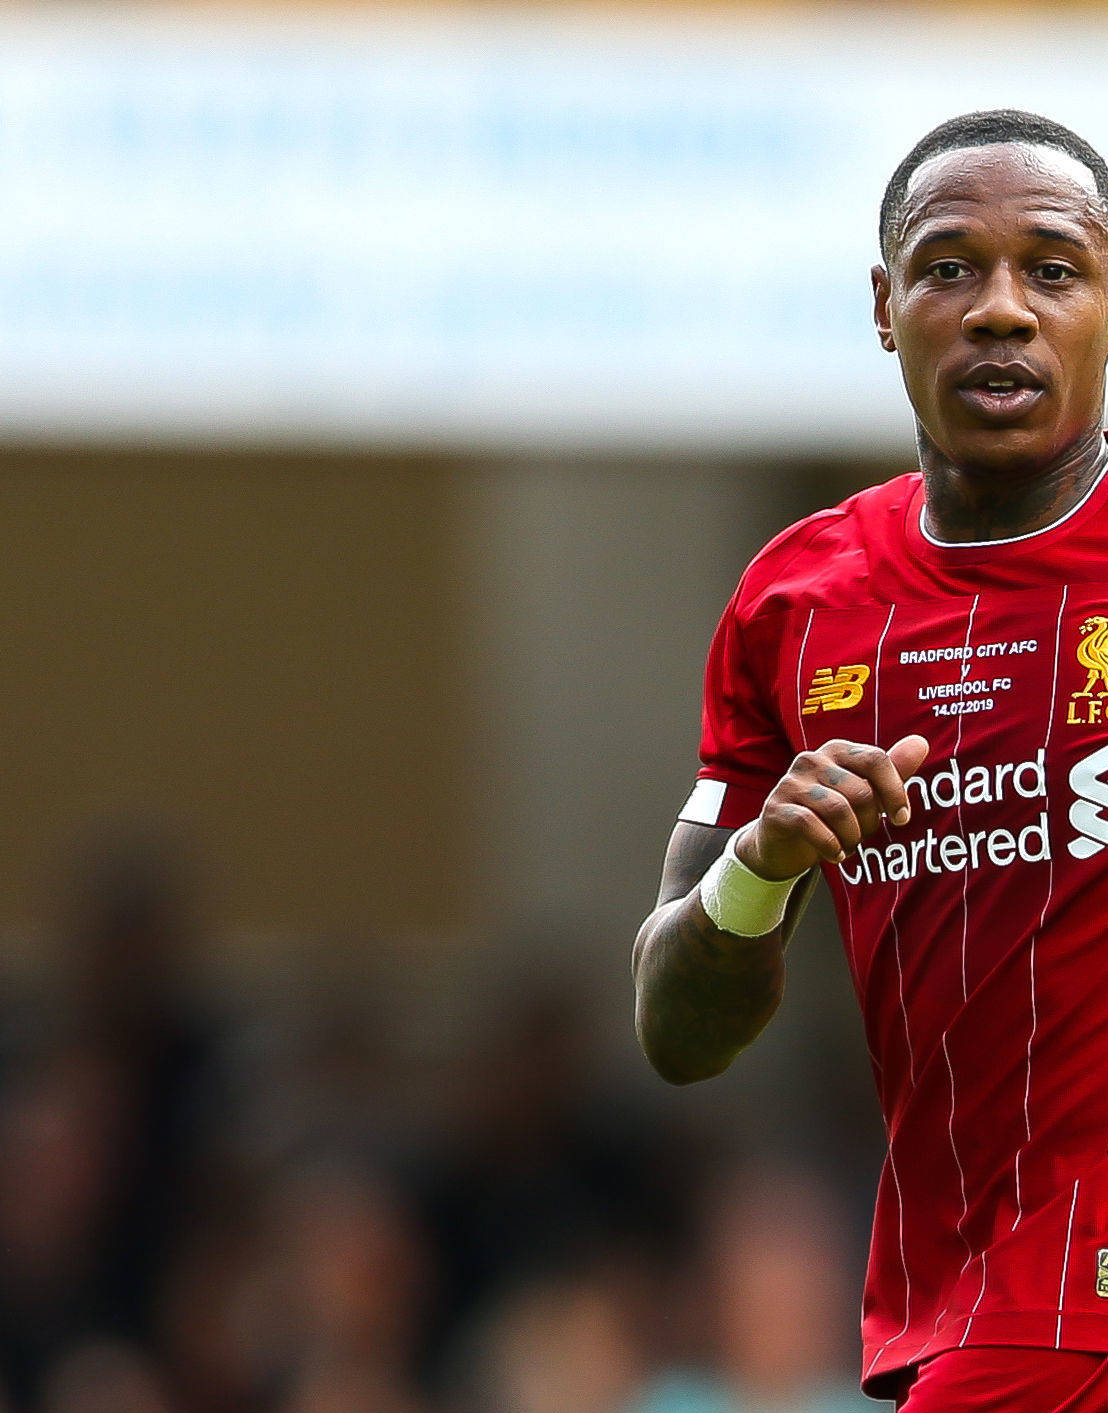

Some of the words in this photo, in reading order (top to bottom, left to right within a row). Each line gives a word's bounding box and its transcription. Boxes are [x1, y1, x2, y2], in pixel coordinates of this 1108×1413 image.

[899, 646, 974, 665] BRADFORD
[976, 642, 1008, 658] CITY
[1008, 639, 1038, 655] AFC
[918, 680, 990, 700] LIVERPOOL
[992, 678, 1012, 691] FC
[932, 698, 994, 717] 14.07.2019
[904, 748, 1048, 811] ndard
